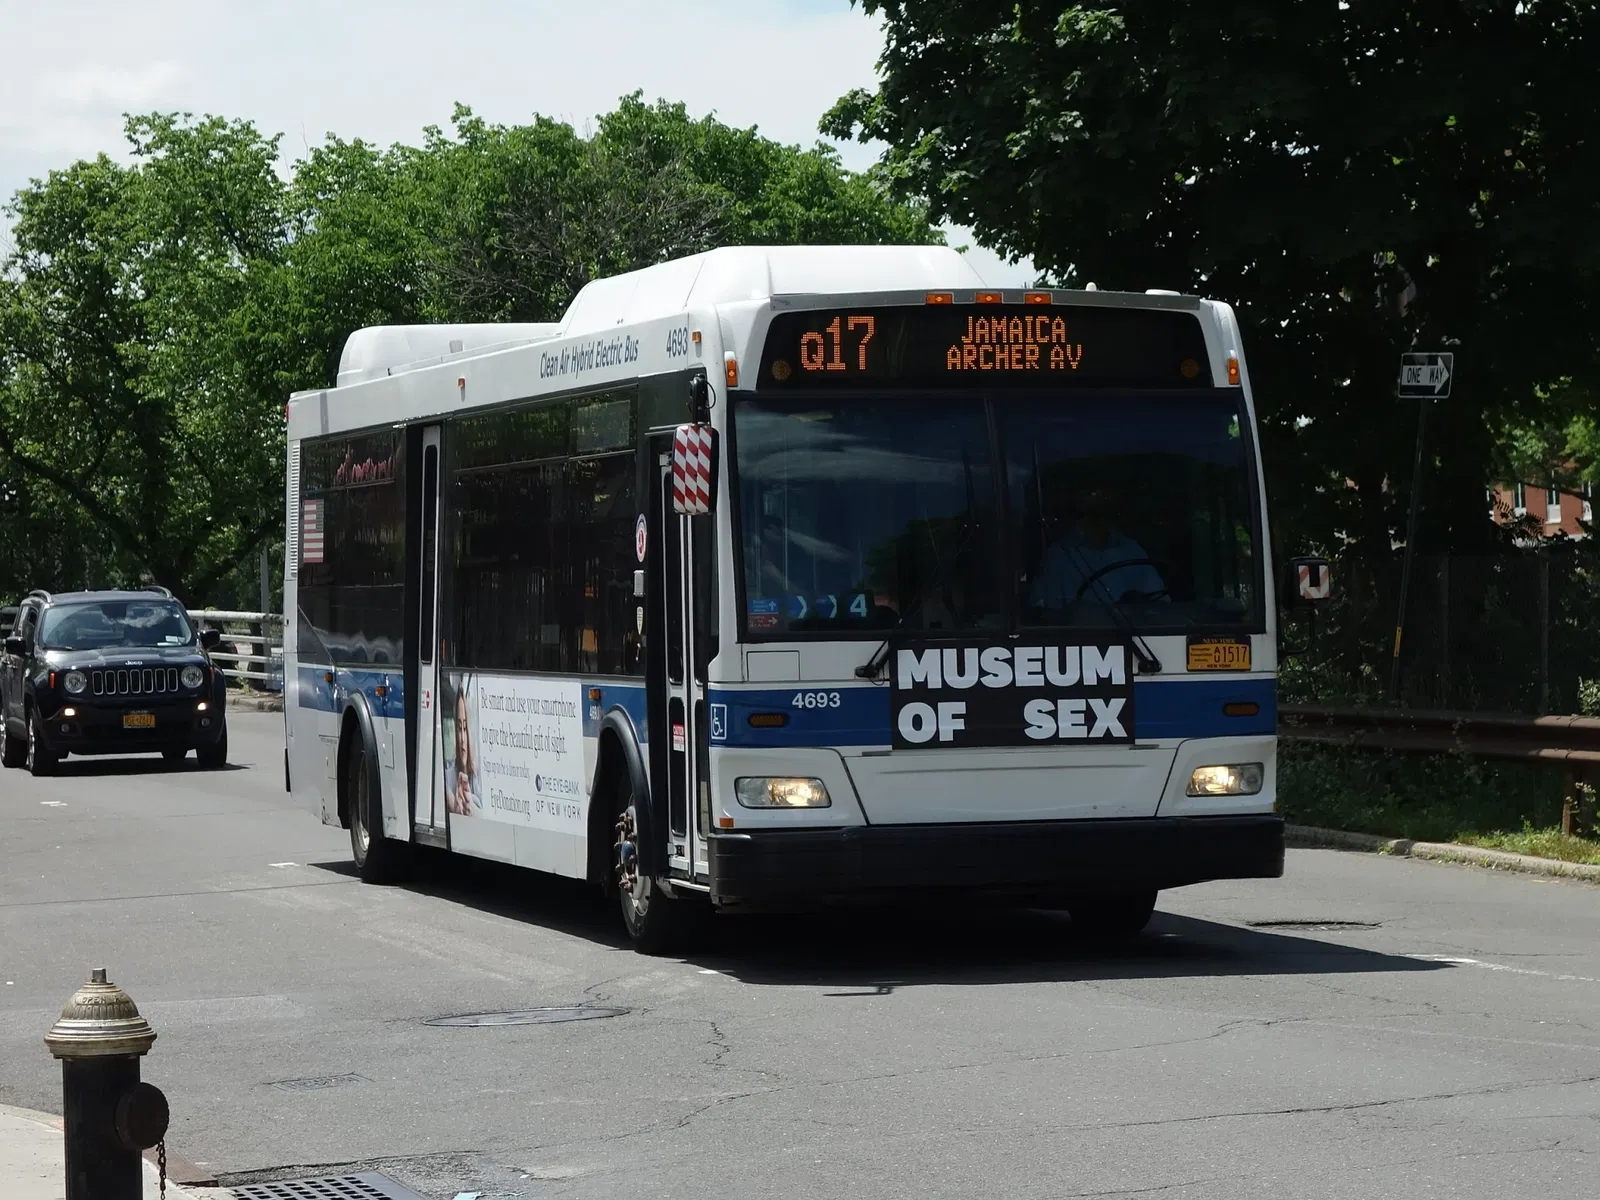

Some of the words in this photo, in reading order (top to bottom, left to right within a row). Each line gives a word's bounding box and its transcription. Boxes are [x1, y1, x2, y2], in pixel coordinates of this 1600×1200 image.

[666, 327, 688, 358] 4693
[800, 315, 875, 370] Q17
[961, 315, 1066, 343] JAMAICA
[540, 351, 558, 379] Clean
[559, 348, 570, 375] Air
[571, 342, 594, 379] Hybrid
[595, 336, 622, 368] Electric
[624, 335, 640, 363] Bus
[947, 344, 1039, 370] ARCHER
[1050, 344, 1082, 370] AV
[1406, 367, 1422, 384] ONE
[1429, 367, 1444, 384] WAY
[897, 645, 1126, 690] MUSEUM
[792, 691, 841, 709] 4693
[897, 701, 967, 744] OF
[1023, 698, 1128, 740] SEX
[536, 799, 544, 812] OF
[547, 802, 560, 816] NEW
[562, 804, 581, 821] YORK
